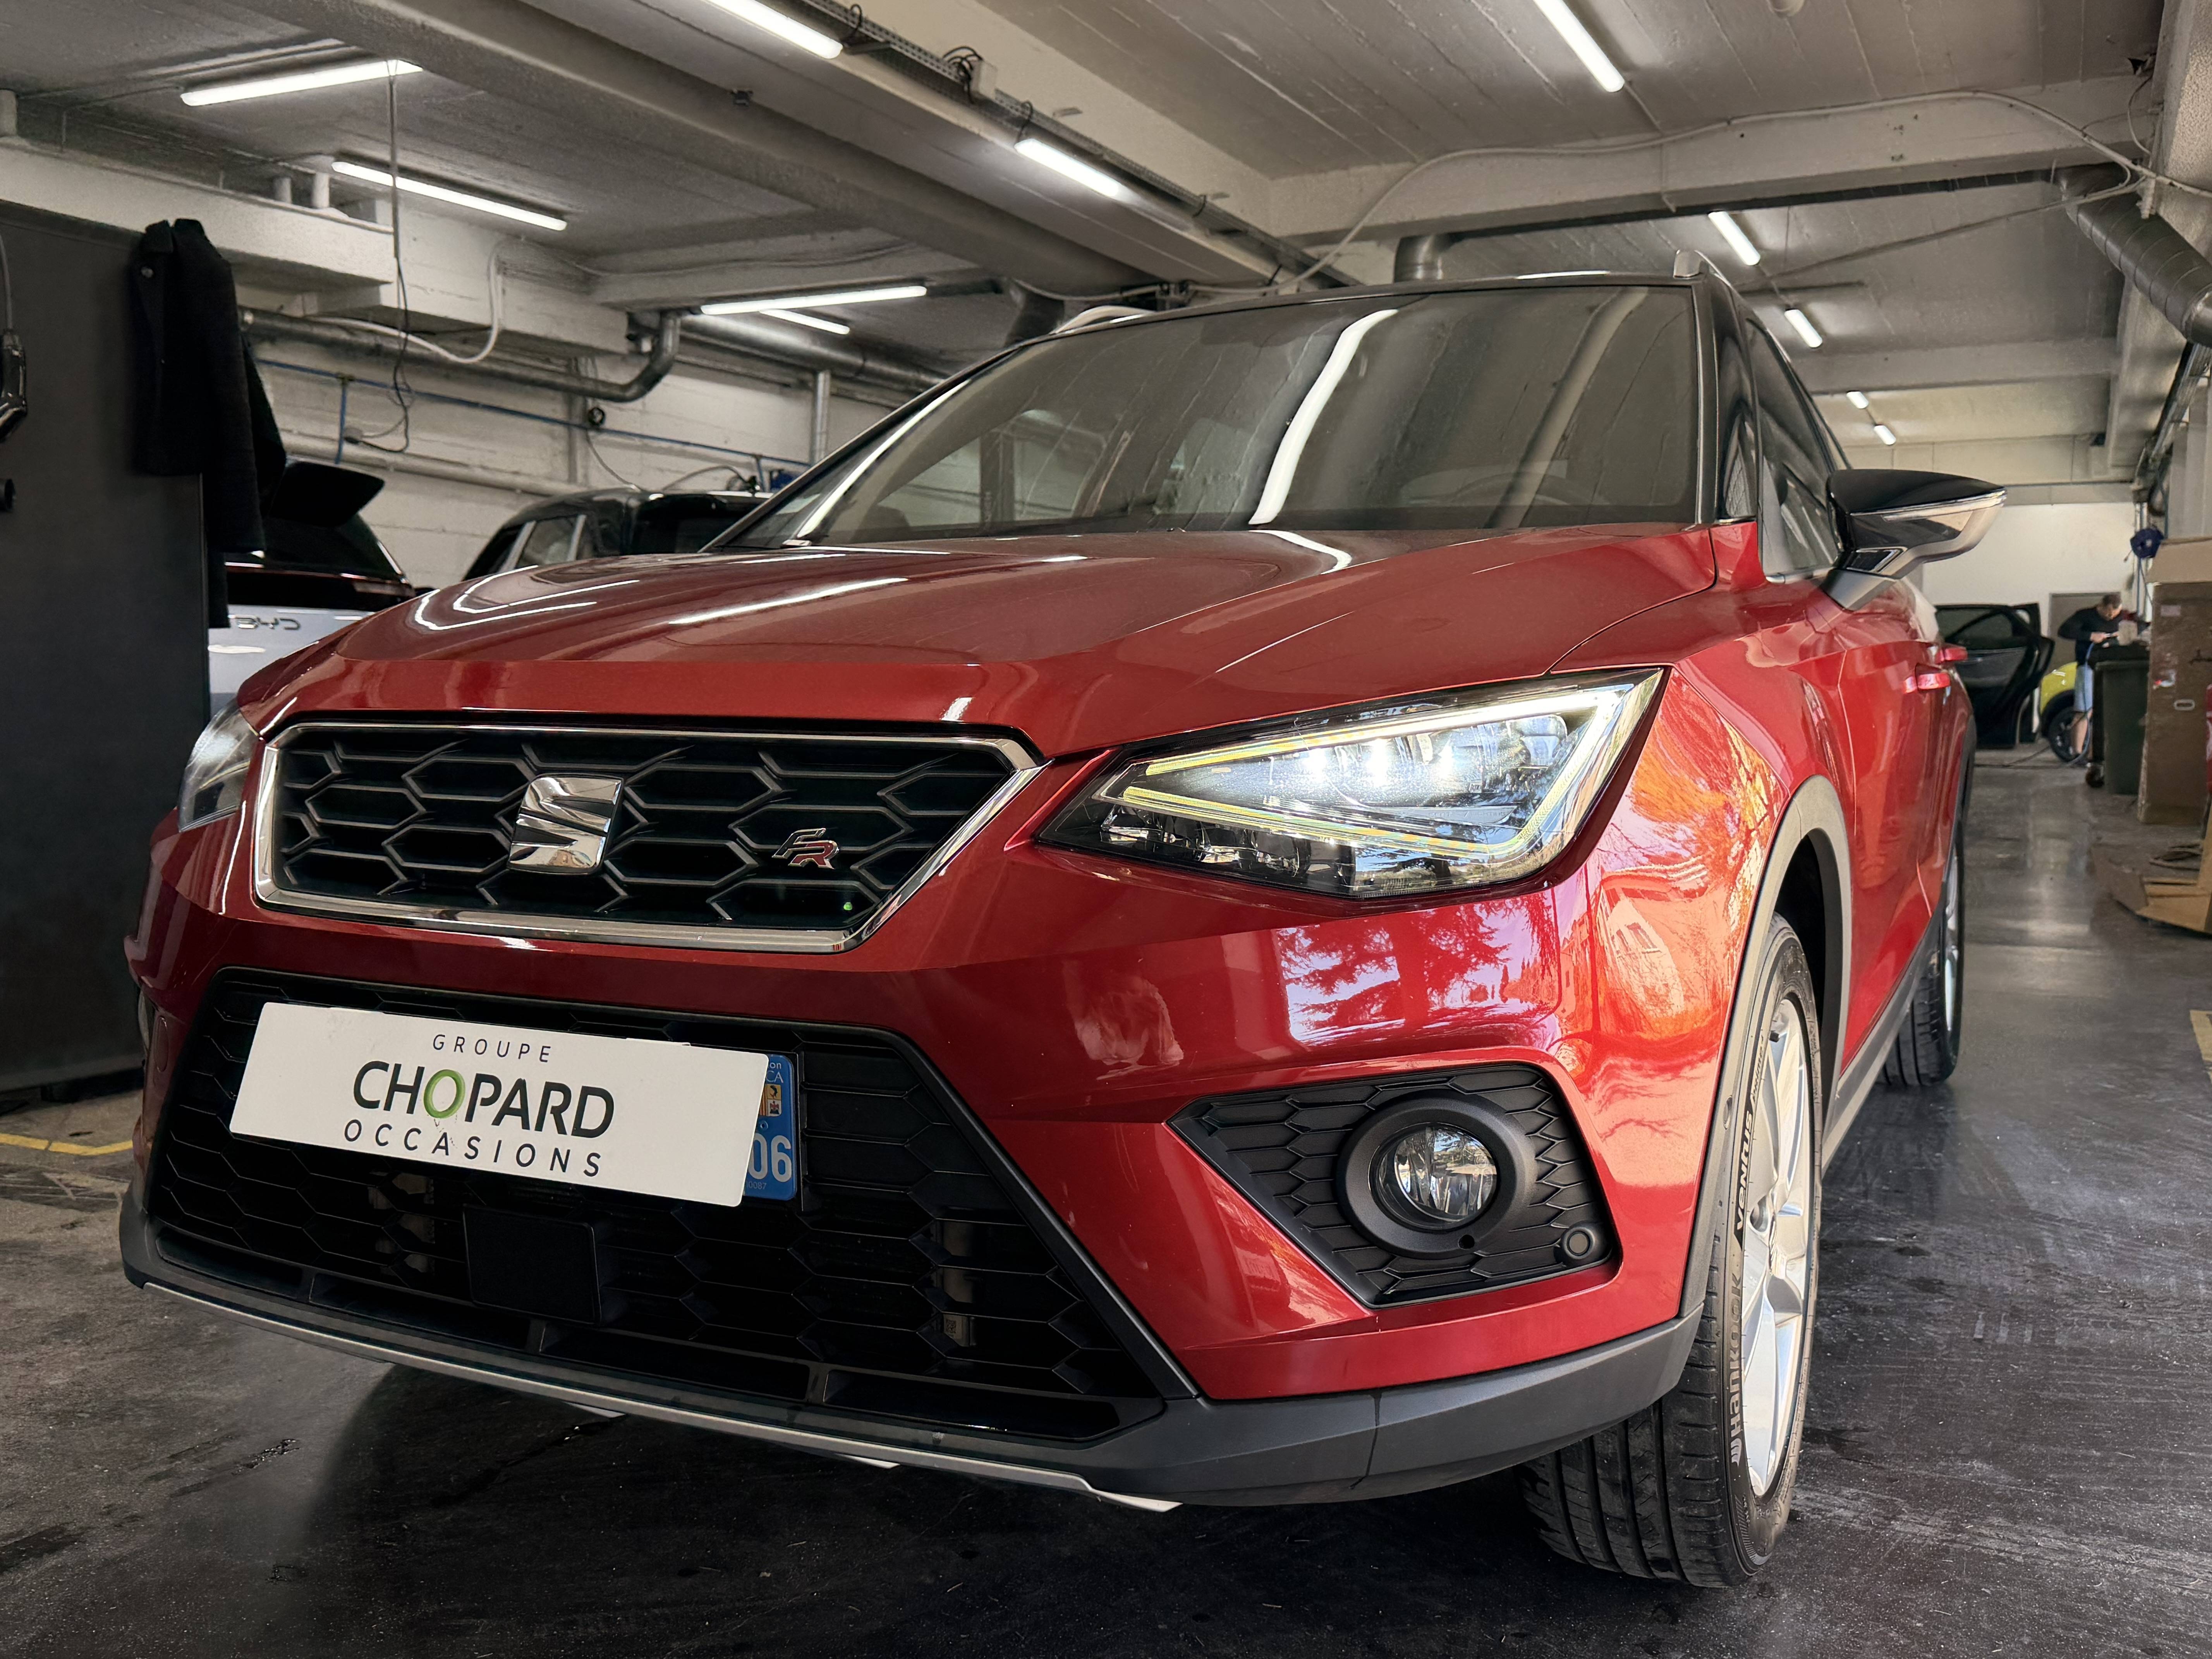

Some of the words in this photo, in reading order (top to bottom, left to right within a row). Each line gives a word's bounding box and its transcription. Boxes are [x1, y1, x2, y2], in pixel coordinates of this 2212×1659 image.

[772, 828, 839, 869] FR
[433, 1034, 551, 1063] GROUPE
[766, 1070, 783, 1083] CA
[353, 1061, 614, 1139] CHOPARD
[344, 1119, 601, 1177] OCCASIONS
[748, 1133, 792, 1182] 06
